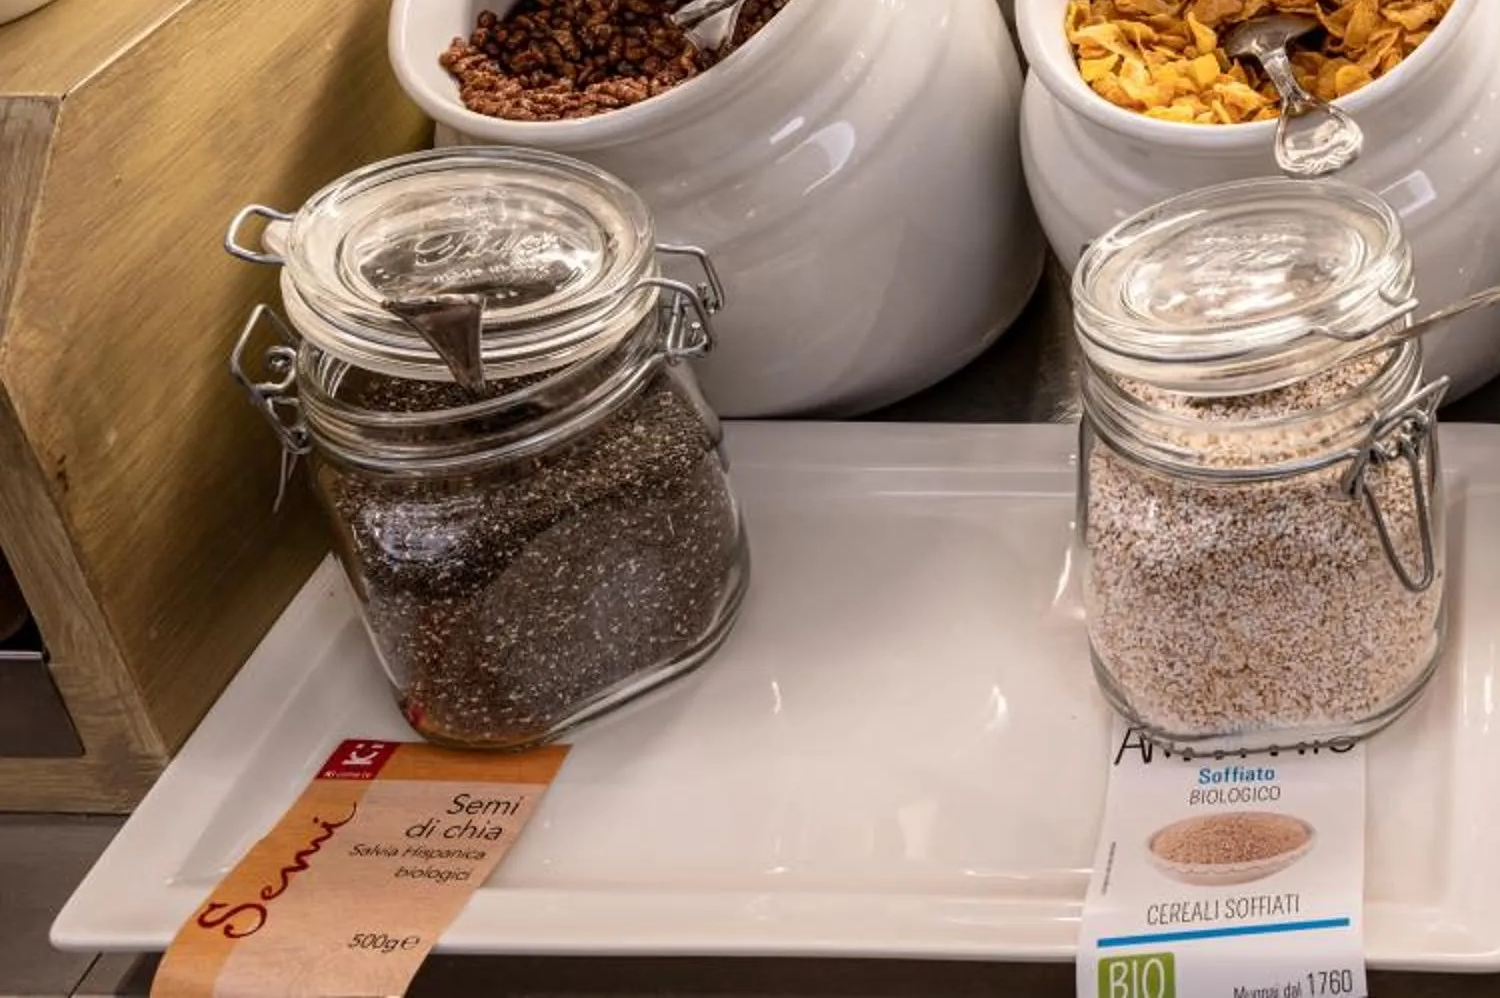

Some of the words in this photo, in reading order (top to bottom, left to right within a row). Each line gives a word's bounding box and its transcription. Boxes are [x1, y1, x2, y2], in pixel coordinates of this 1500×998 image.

[1198, 766, 1276, 784] Soffiato
[446, 793, 525, 817] Semi
[1189, 785, 1281, 805] BIOLOGICO
[405, 817, 441, 839] di
[443, 818, 503, 840] chia
[350, 843, 399, 858] Salvia
[402, 846, 487, 861] Hispanica
[196, 801, 357, 939] Semi
[394, 866, 472, 883] biologici
[1147, 899, 1219, 925] CEREALI
[1224, 893, 1300, 919] SOFFIATI
[1109, 958, 1165, 998] BIO
[1306, 969, 1353, 996] 1760
